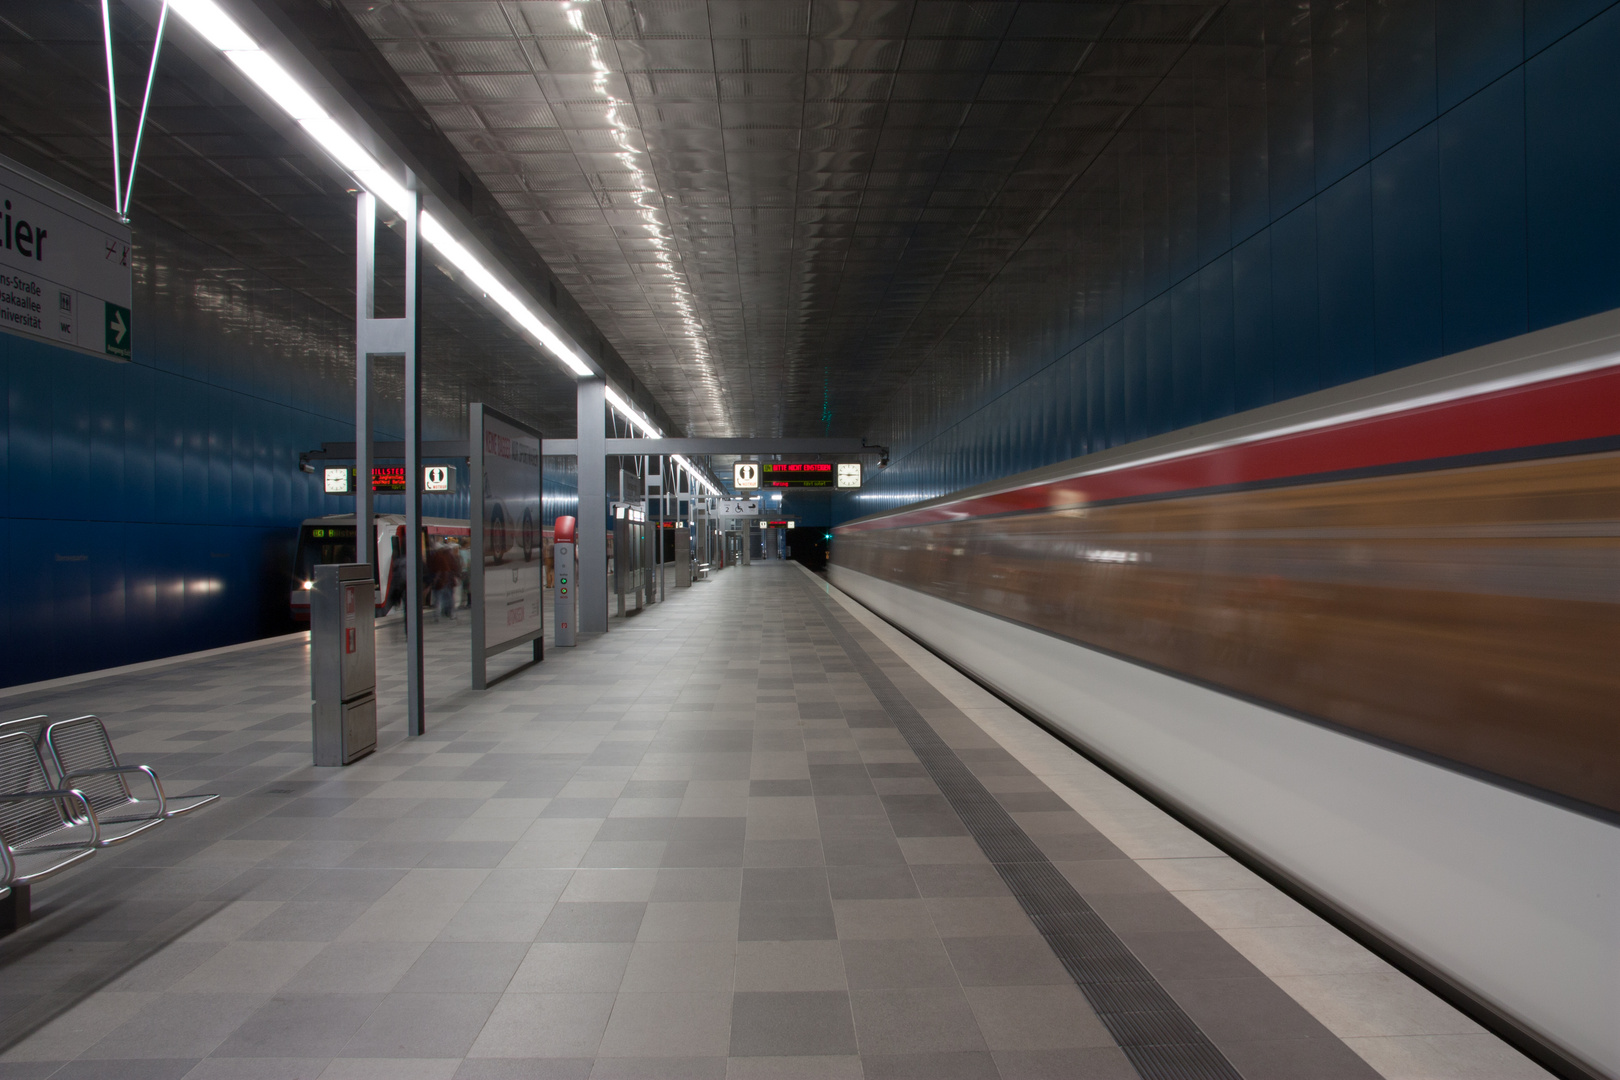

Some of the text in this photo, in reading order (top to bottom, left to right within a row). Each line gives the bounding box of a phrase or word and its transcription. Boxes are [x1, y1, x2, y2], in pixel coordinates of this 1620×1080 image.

[0, 199, 47, 262] ier
[0, 290, 42, 314] sakaallee
[0, 307, 42, 330] niversität
